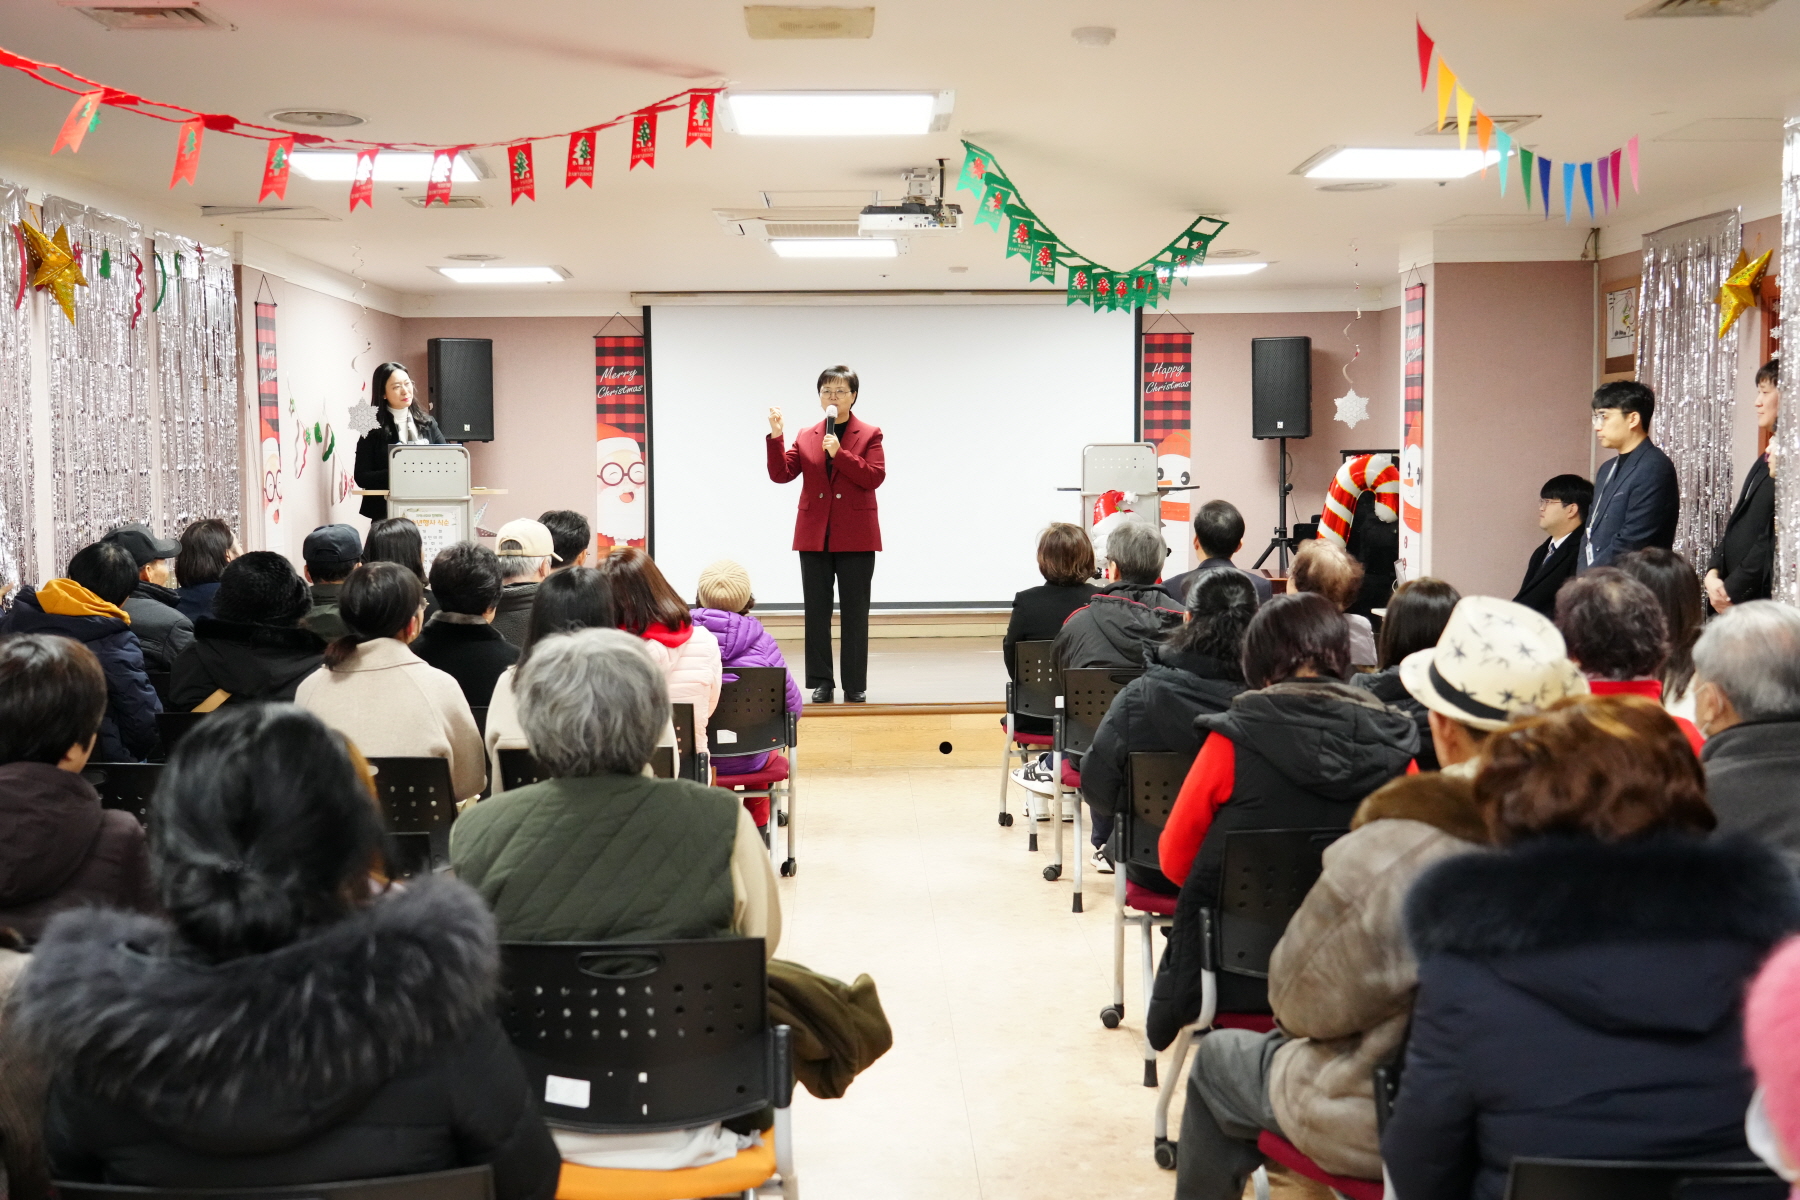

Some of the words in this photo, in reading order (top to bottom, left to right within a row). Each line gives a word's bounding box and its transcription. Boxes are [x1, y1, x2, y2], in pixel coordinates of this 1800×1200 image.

[599, 366, 638, 383] Merry
[1151, 362, 1186, 379] Happy
[597, 384, 644, 398] Christmas
[1145, 380, 1191, 394] Christmas
